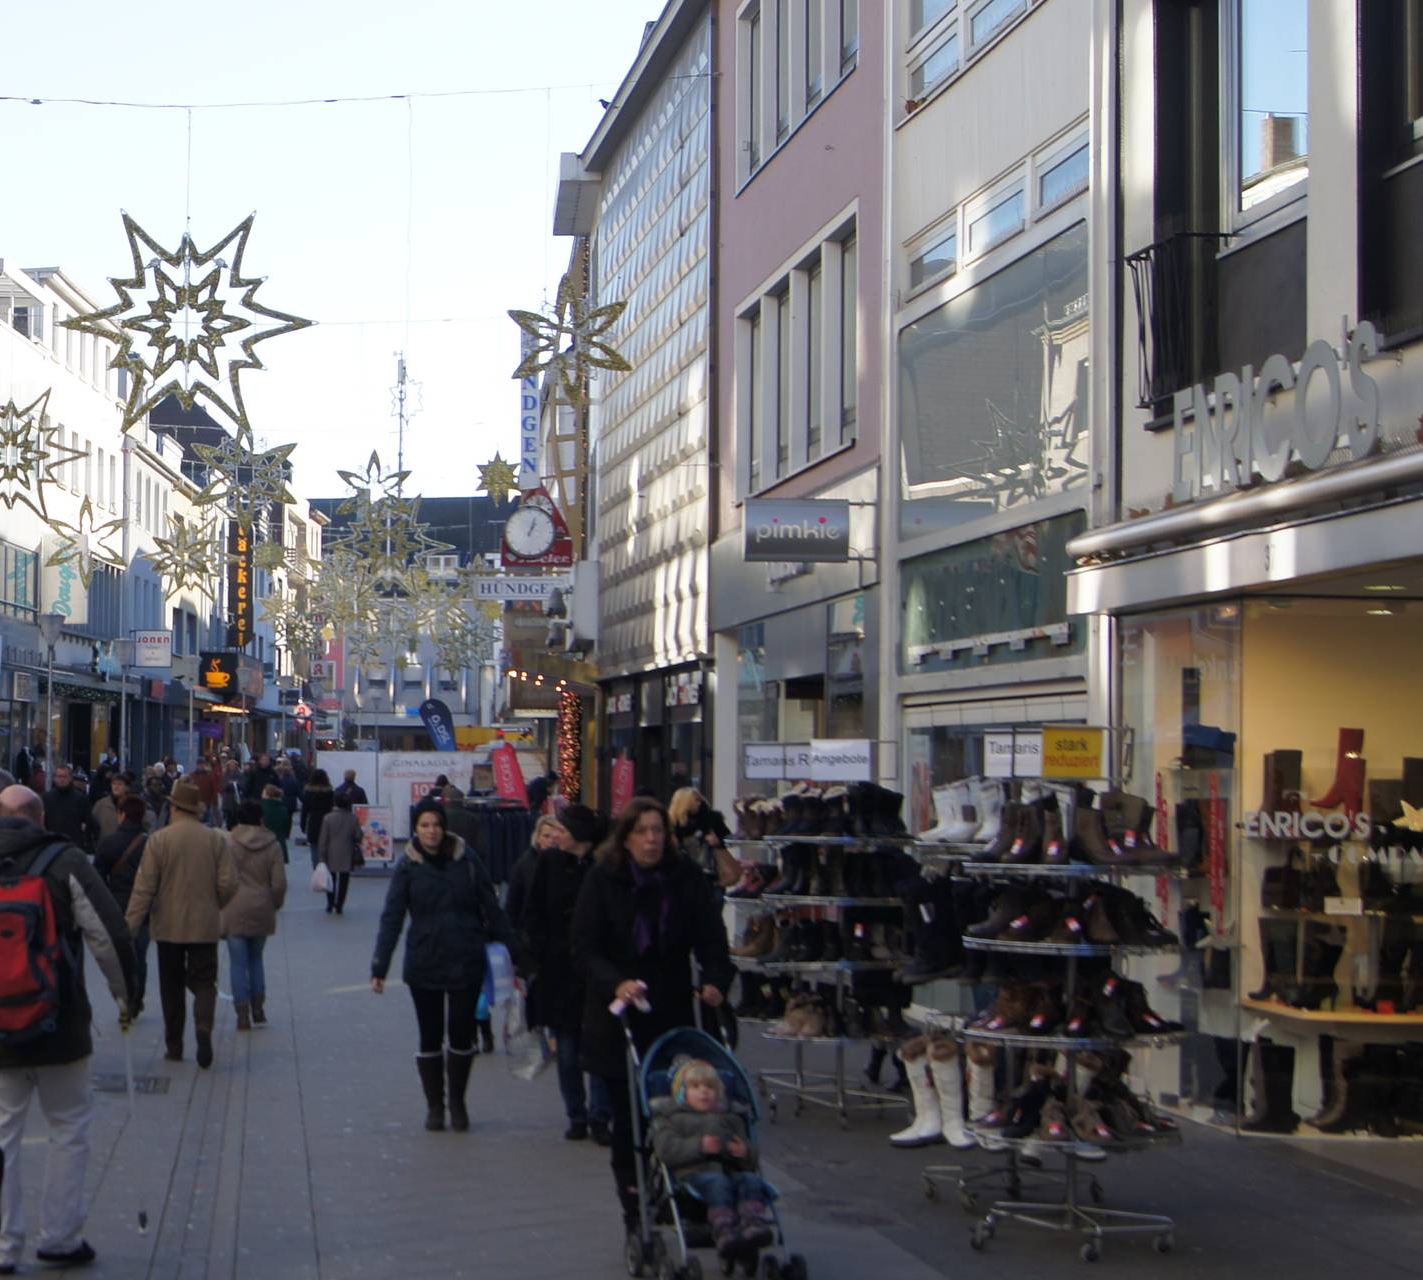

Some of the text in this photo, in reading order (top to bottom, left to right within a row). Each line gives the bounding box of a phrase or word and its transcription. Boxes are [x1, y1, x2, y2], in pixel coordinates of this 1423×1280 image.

[1173, 315, 1379, 502] ENRICO'S
[755, 516, 841, 543] pimkie
[1057, 737, 1088, 751] stark
[813, 754, 868, 767] Angebote
[1244, 810, 1372, 839] ENRICO'S
